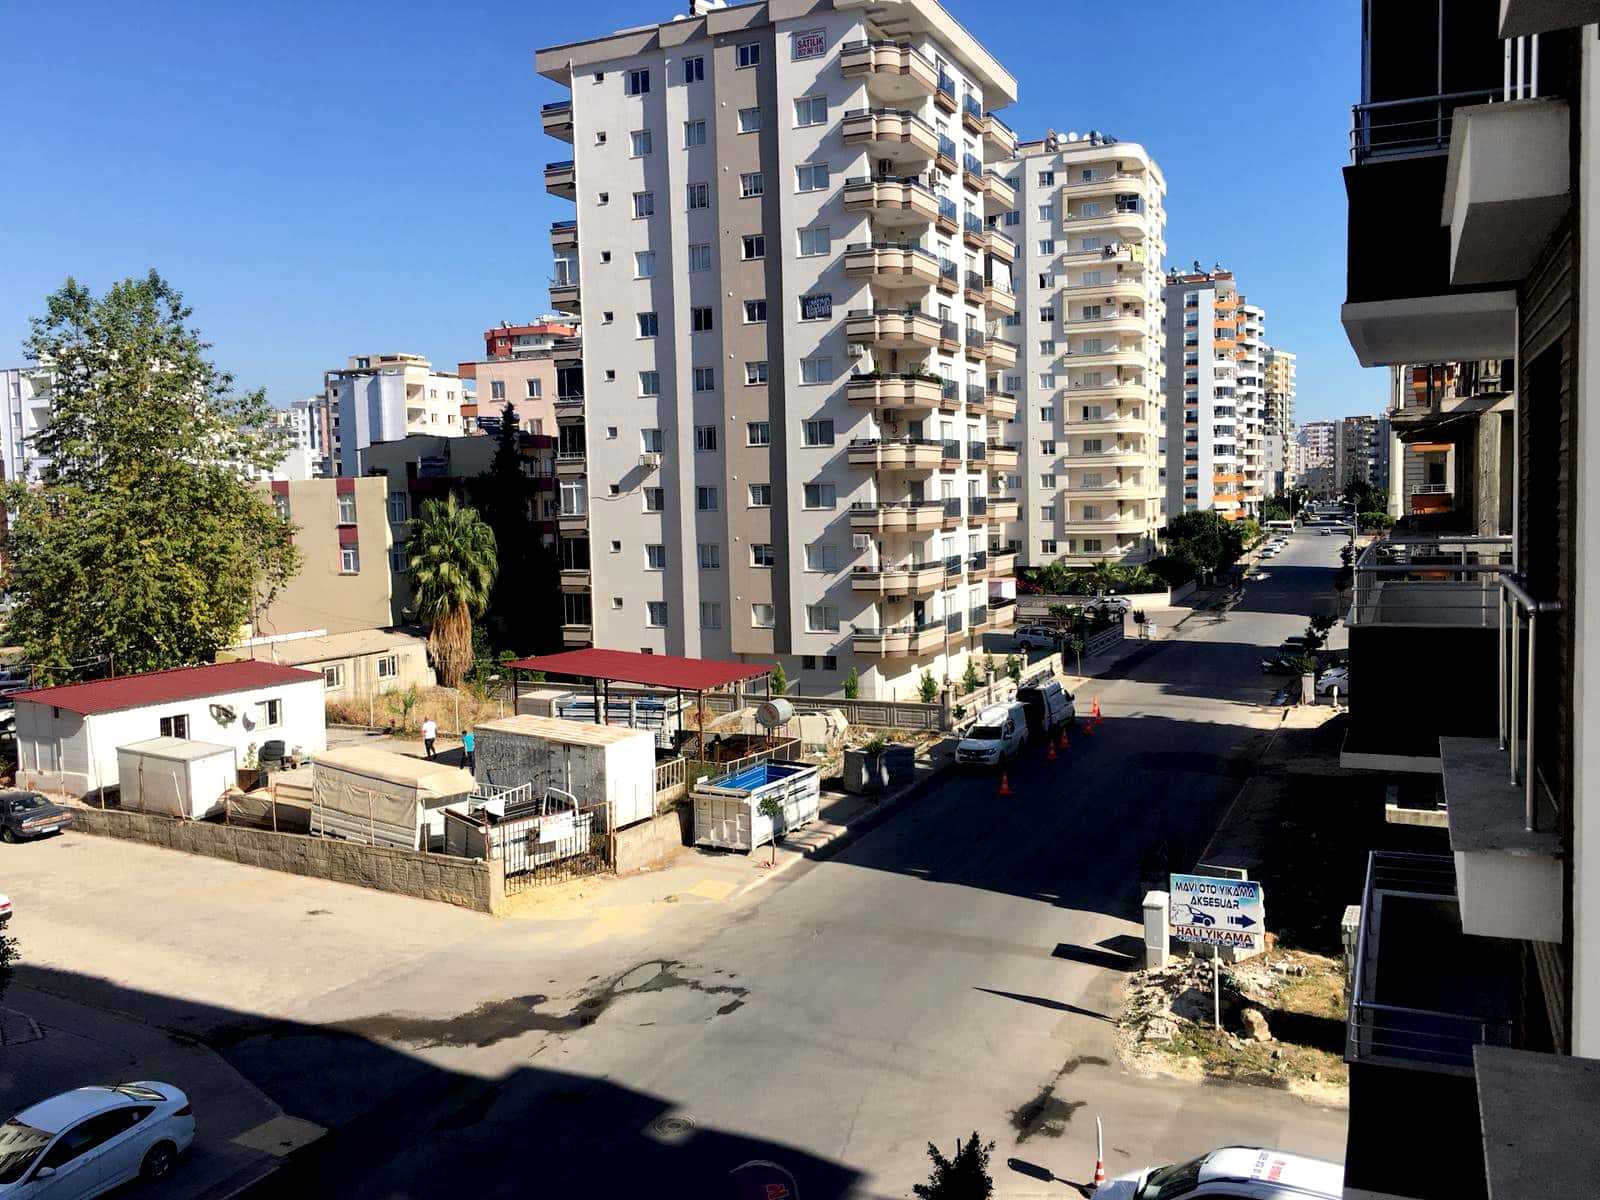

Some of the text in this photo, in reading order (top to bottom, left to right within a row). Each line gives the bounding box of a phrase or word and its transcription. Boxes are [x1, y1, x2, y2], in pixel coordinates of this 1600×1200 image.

[1199, 883, 1217, 894] OTO
[1190, 896, 1240, 909] AKSESUAR
[1176, 926, 1202, 937] HALI
[1205, 929, 1252, 943] YIKAMA
